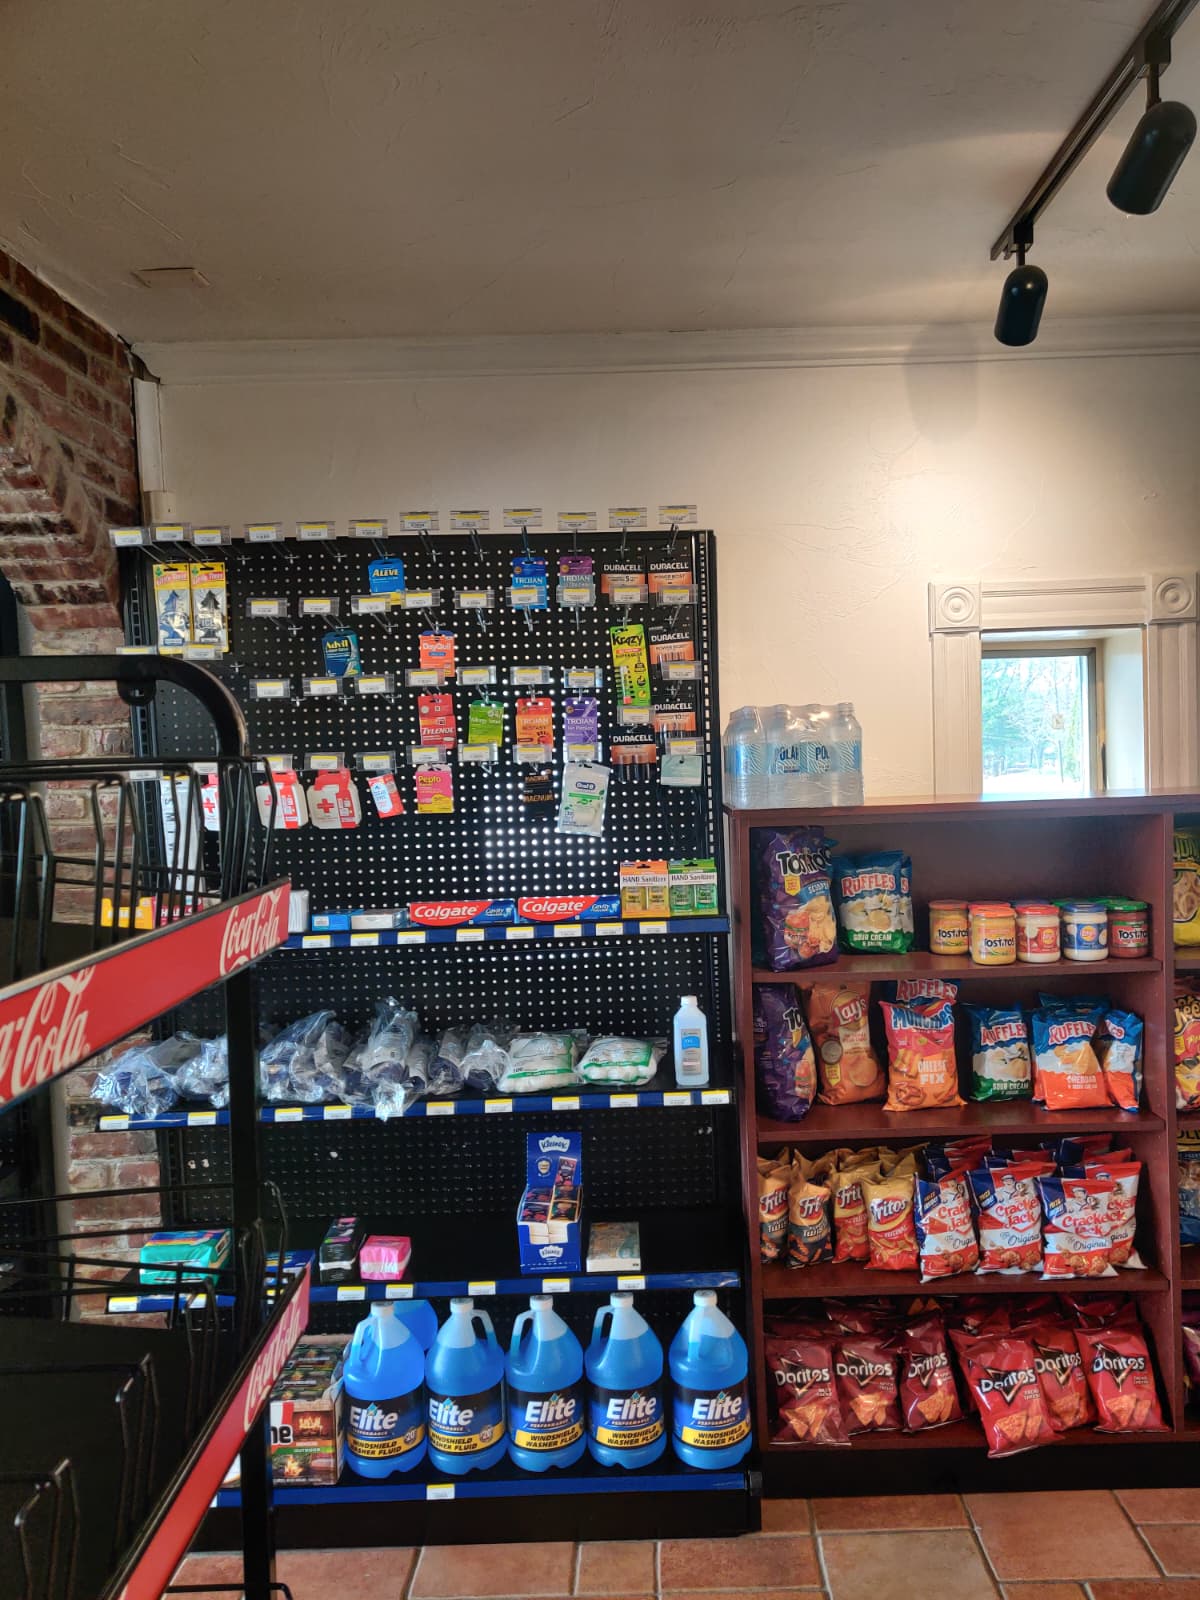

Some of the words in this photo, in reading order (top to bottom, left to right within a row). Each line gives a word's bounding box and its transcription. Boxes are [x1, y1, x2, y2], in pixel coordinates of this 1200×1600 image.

[372, 569, 398, 578] ALEVE
[650, 562, 689, 571] DURACELL
[326, 639, 349, 650] Advil
[651, 632, 690, 642] DURACELL
[654, 702, 693, 711] DURACELL
[422, 727, 454, 735] TYLENOL
[612, 735, 653, 743] DURACELL
[841, 872, 896, 898] RUFFLES
[414, 905, 479, 920] Colgate
[521, 900, 586, 914] Colgate
[897, 979, 958, 1003] RUFFLES
[834, 999, 867, 1026] Lay's
[919, 1072, 945, 1085] FIX
[870, 1198, 907, 1223] Fritos
[1004, 1211, 1034, 1230] Jack
[1073, 1238, 1108, 1250] Original
[836, 1363, 893, 1377] Doritos
[908, 1352, 948, 1378] Doritos
[1034, 1352, 1082, 1374] Doritos
[1093, 1356, 1145, 1373] Doritos
[775, 1368, 830, 1386] Doritos
[981, 1368, 1036, 1393] Doritos
[429, 1398, 474, 1426] Elite
[525, 1397, 576, 1423] Elite
[607, 1397, 657, 1421] Elite
[692, 1397, 742, 1420] Elite
[350, 1405, 399, 1431] Elite
[431, 1432, 473, 1444] WINDSHIELD
[525, 1439, 558, 1448] WASHER
[560, 1431, 579, 1446] FLUID
[530, 1427, 576, 1442] WINDSHIELD
[607, 1436, 640, 1446] WASHER
[642, 1430, 659, 1444] FLUID
[612, 1425, 657, 1440] WINDSHIELD
[693, 1436, 725, 1446] WASHER
[727, 1429, 745, 1444] FLUID
[699, 1425, 743, 1440] WINDSHIELD
[352, 1439, 398, 1450] WINDSHIELD
[378, 1445, 402, 1456] FLUID
[455, 1442, 478, 1451] FLUID
